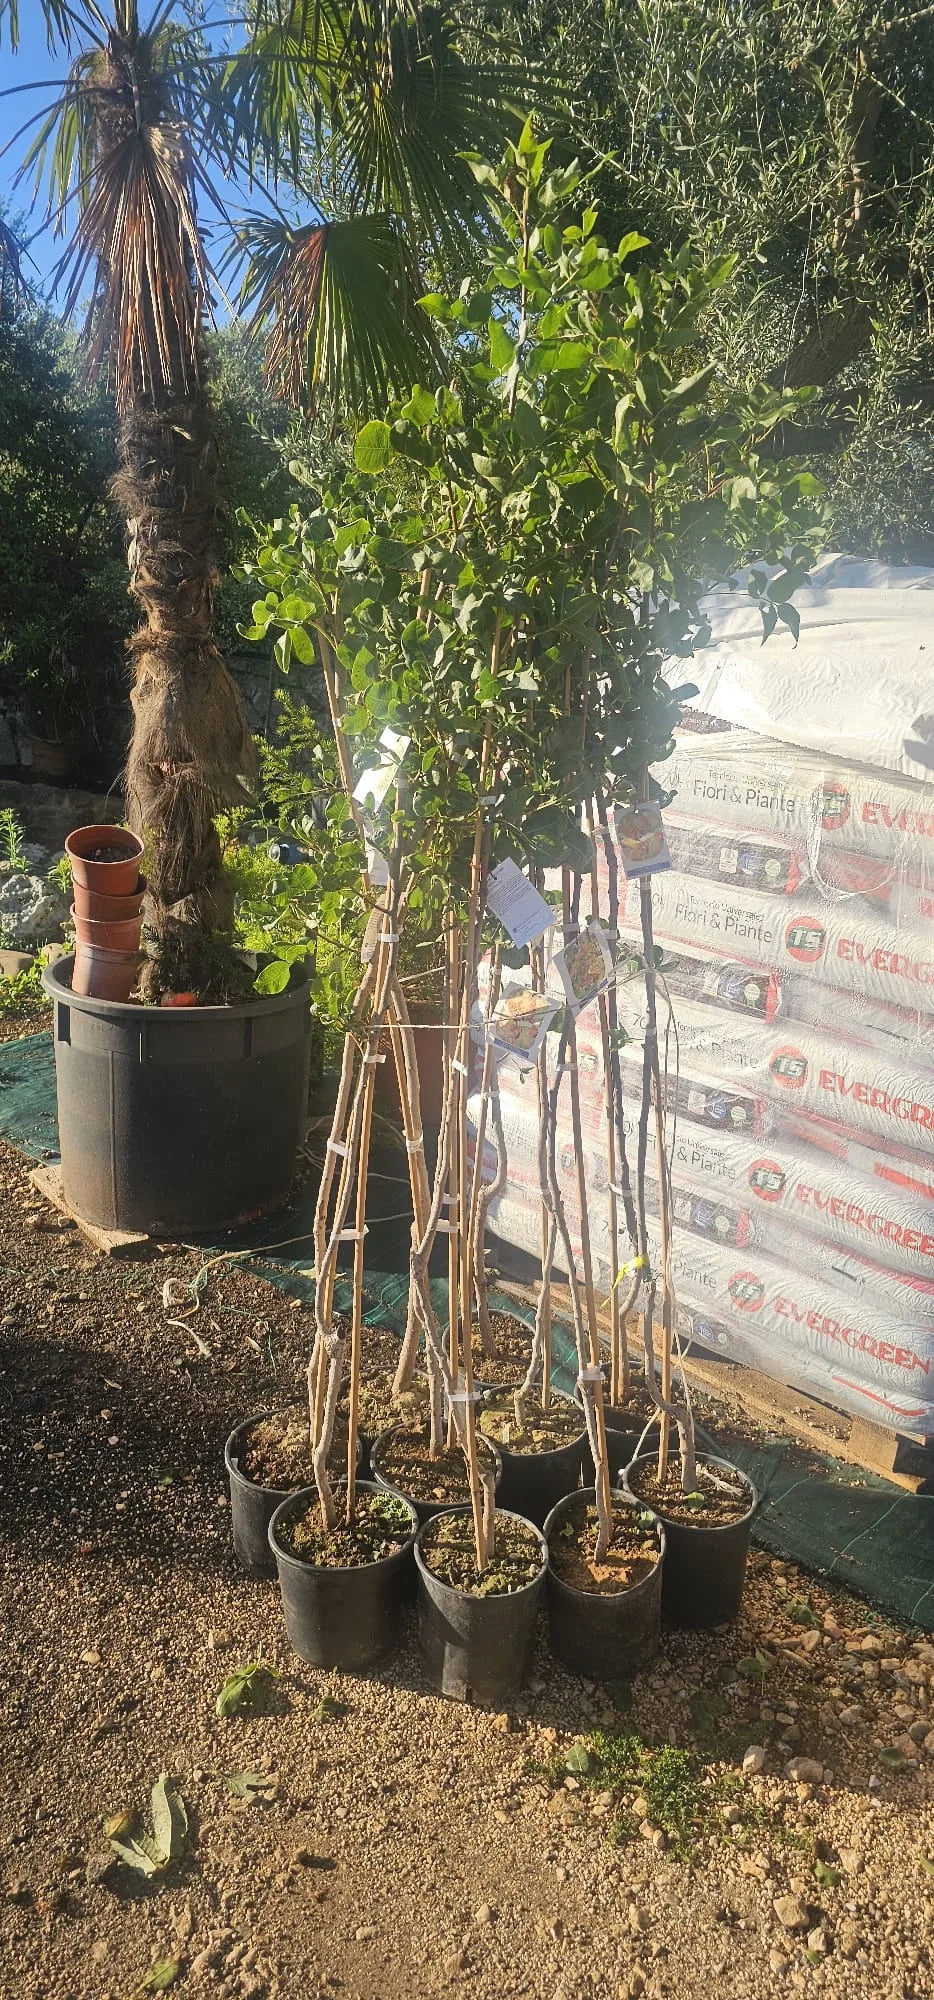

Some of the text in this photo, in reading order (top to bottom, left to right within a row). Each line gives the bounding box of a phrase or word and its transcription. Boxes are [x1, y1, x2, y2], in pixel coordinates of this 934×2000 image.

[693, 779, 795, 813] Fiori & Piante
[675, 903, 773, 943] Fiori & Piante
[819, 1069, 934, 1131] EVERGR
[677, 1146, 736, 1180] & Piante
[674, 1258, 717, 1288] Piante
[774, 1295, 931, 1375] EVERGREEN
